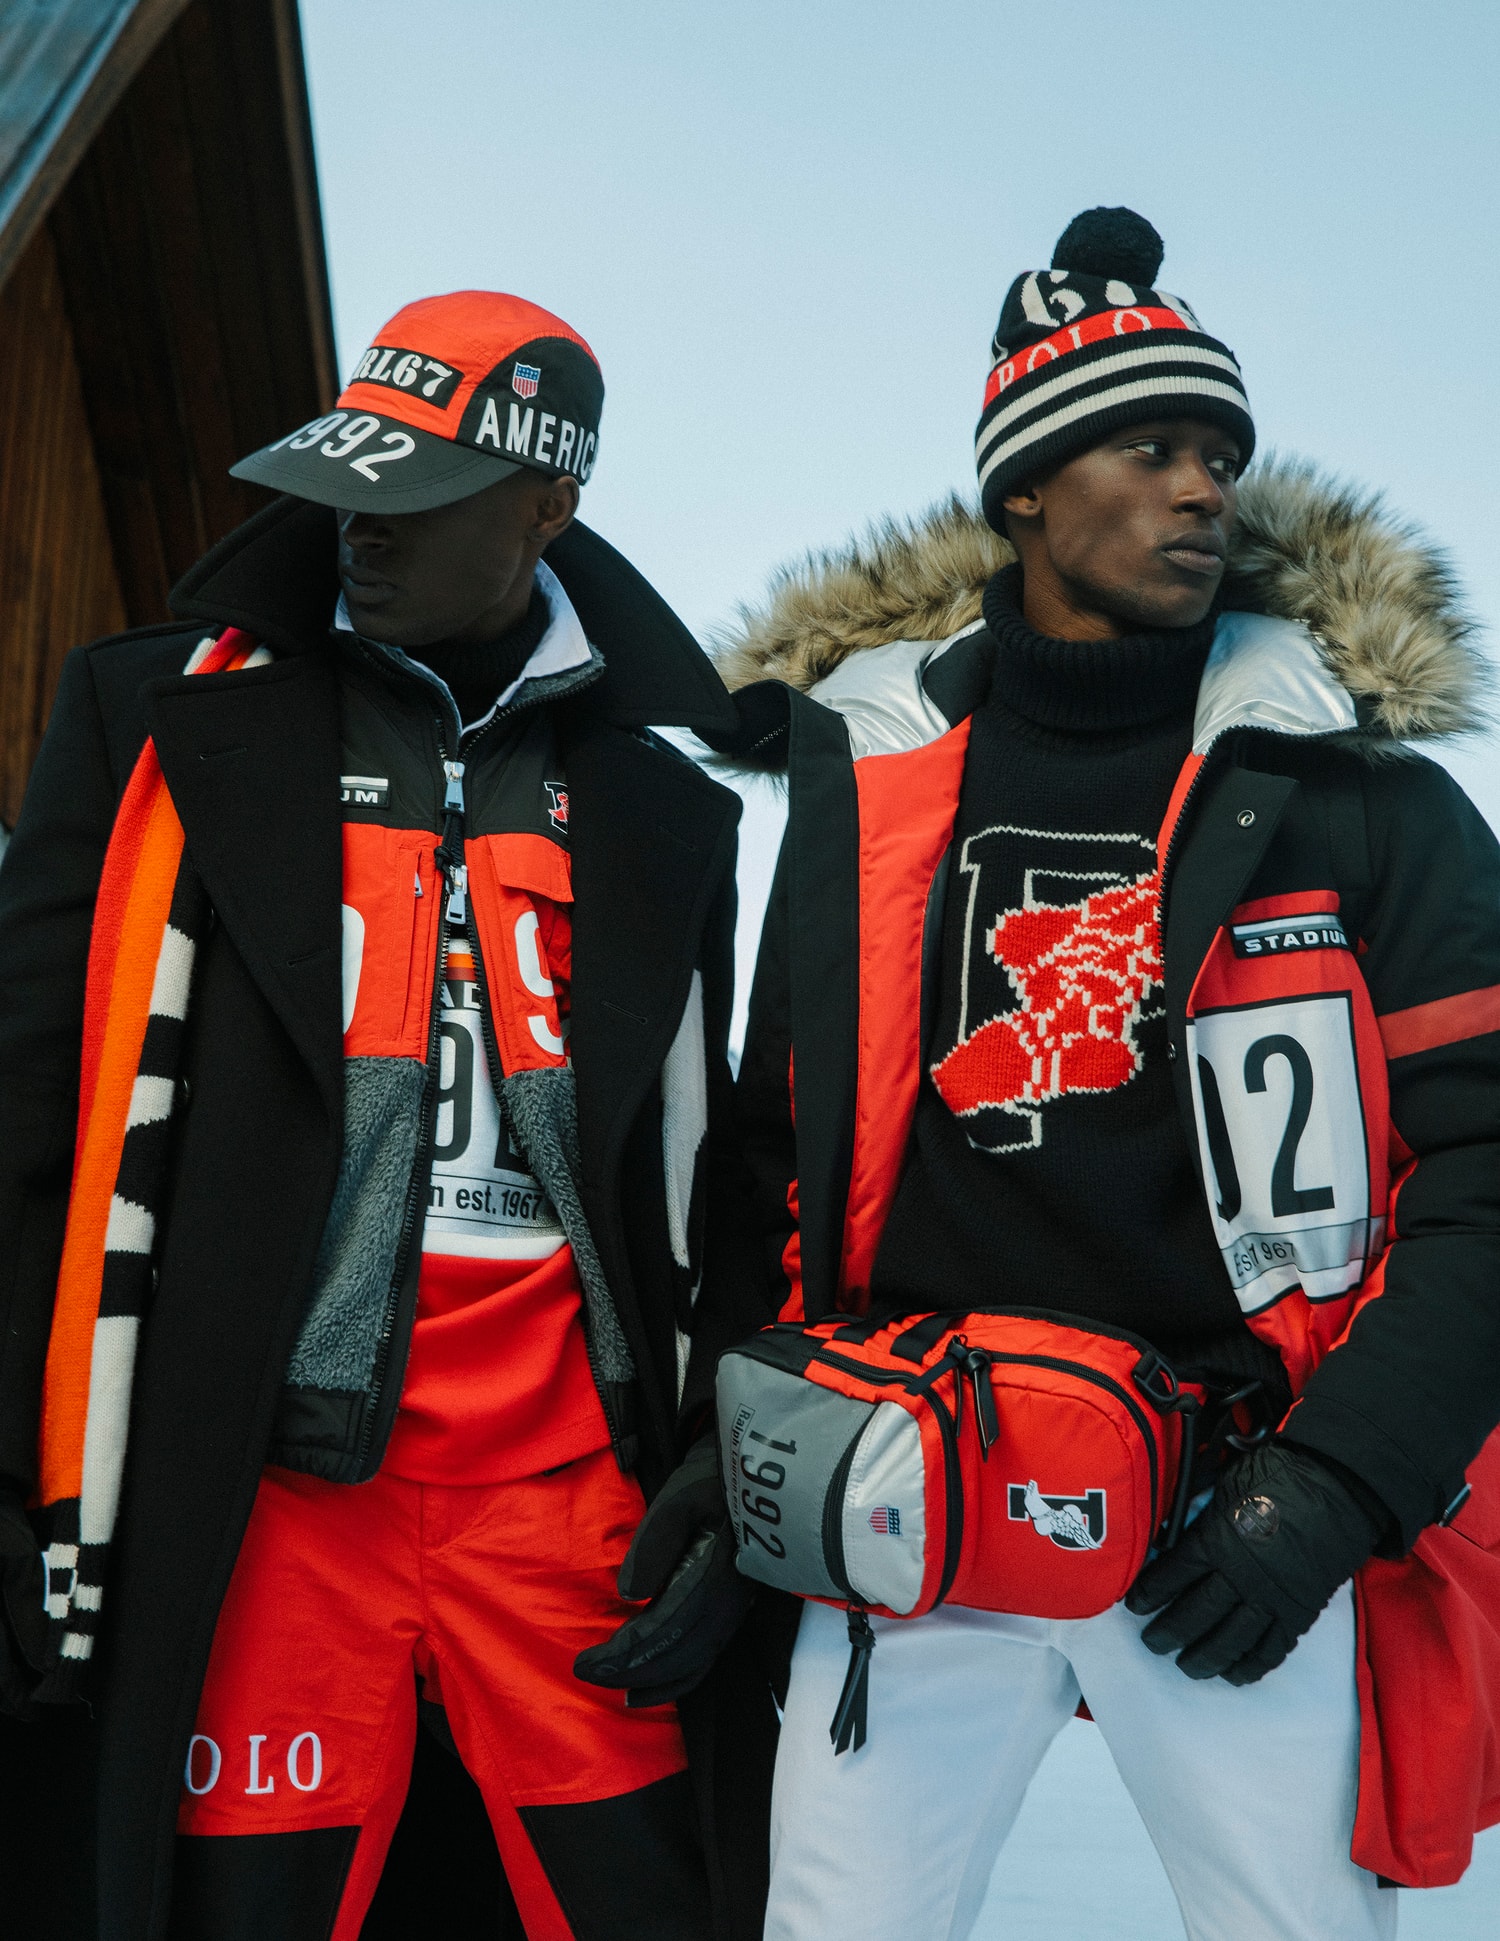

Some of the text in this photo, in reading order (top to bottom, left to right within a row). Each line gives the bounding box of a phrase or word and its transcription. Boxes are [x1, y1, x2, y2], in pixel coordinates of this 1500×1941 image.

[269, 412, 416, 483] 1992
[731, 1408, 751, 1447] Ralph
[740, 1429, 798, 1560] 1992
